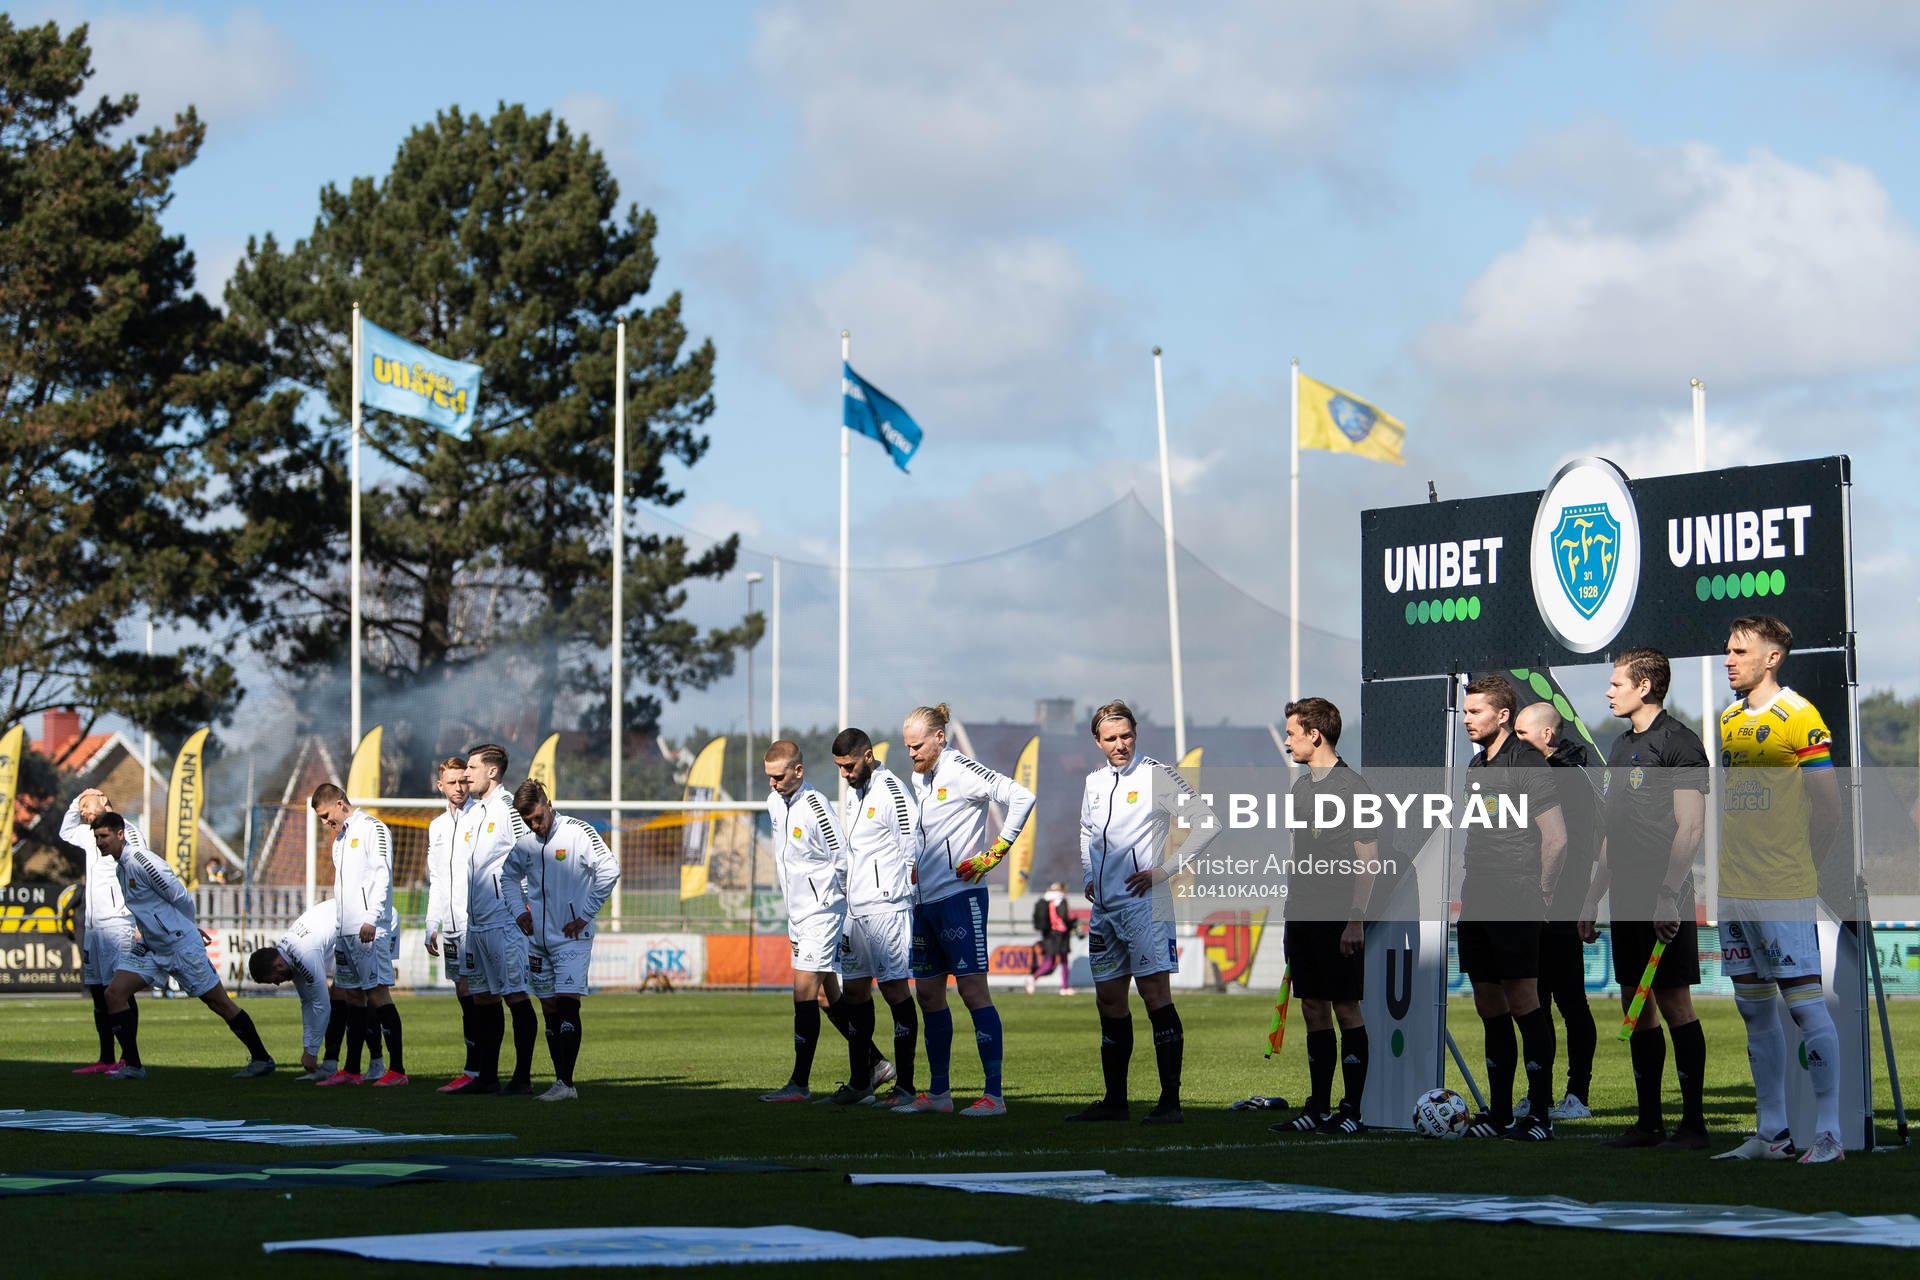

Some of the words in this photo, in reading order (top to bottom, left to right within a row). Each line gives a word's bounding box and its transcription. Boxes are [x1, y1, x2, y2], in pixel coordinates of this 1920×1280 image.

[1668, 505, 1812, 568] UNIBET
[1384, 536, 1503, 594] UNIBET
[1578, 585, 1599, 599] 1928
[1737, 727, 1754, 736] FBG
[646, 950, 686, 970] SK
[19, 973, 56, 984] MORE
[1422, 1106, 1444, 1133] SELECT
